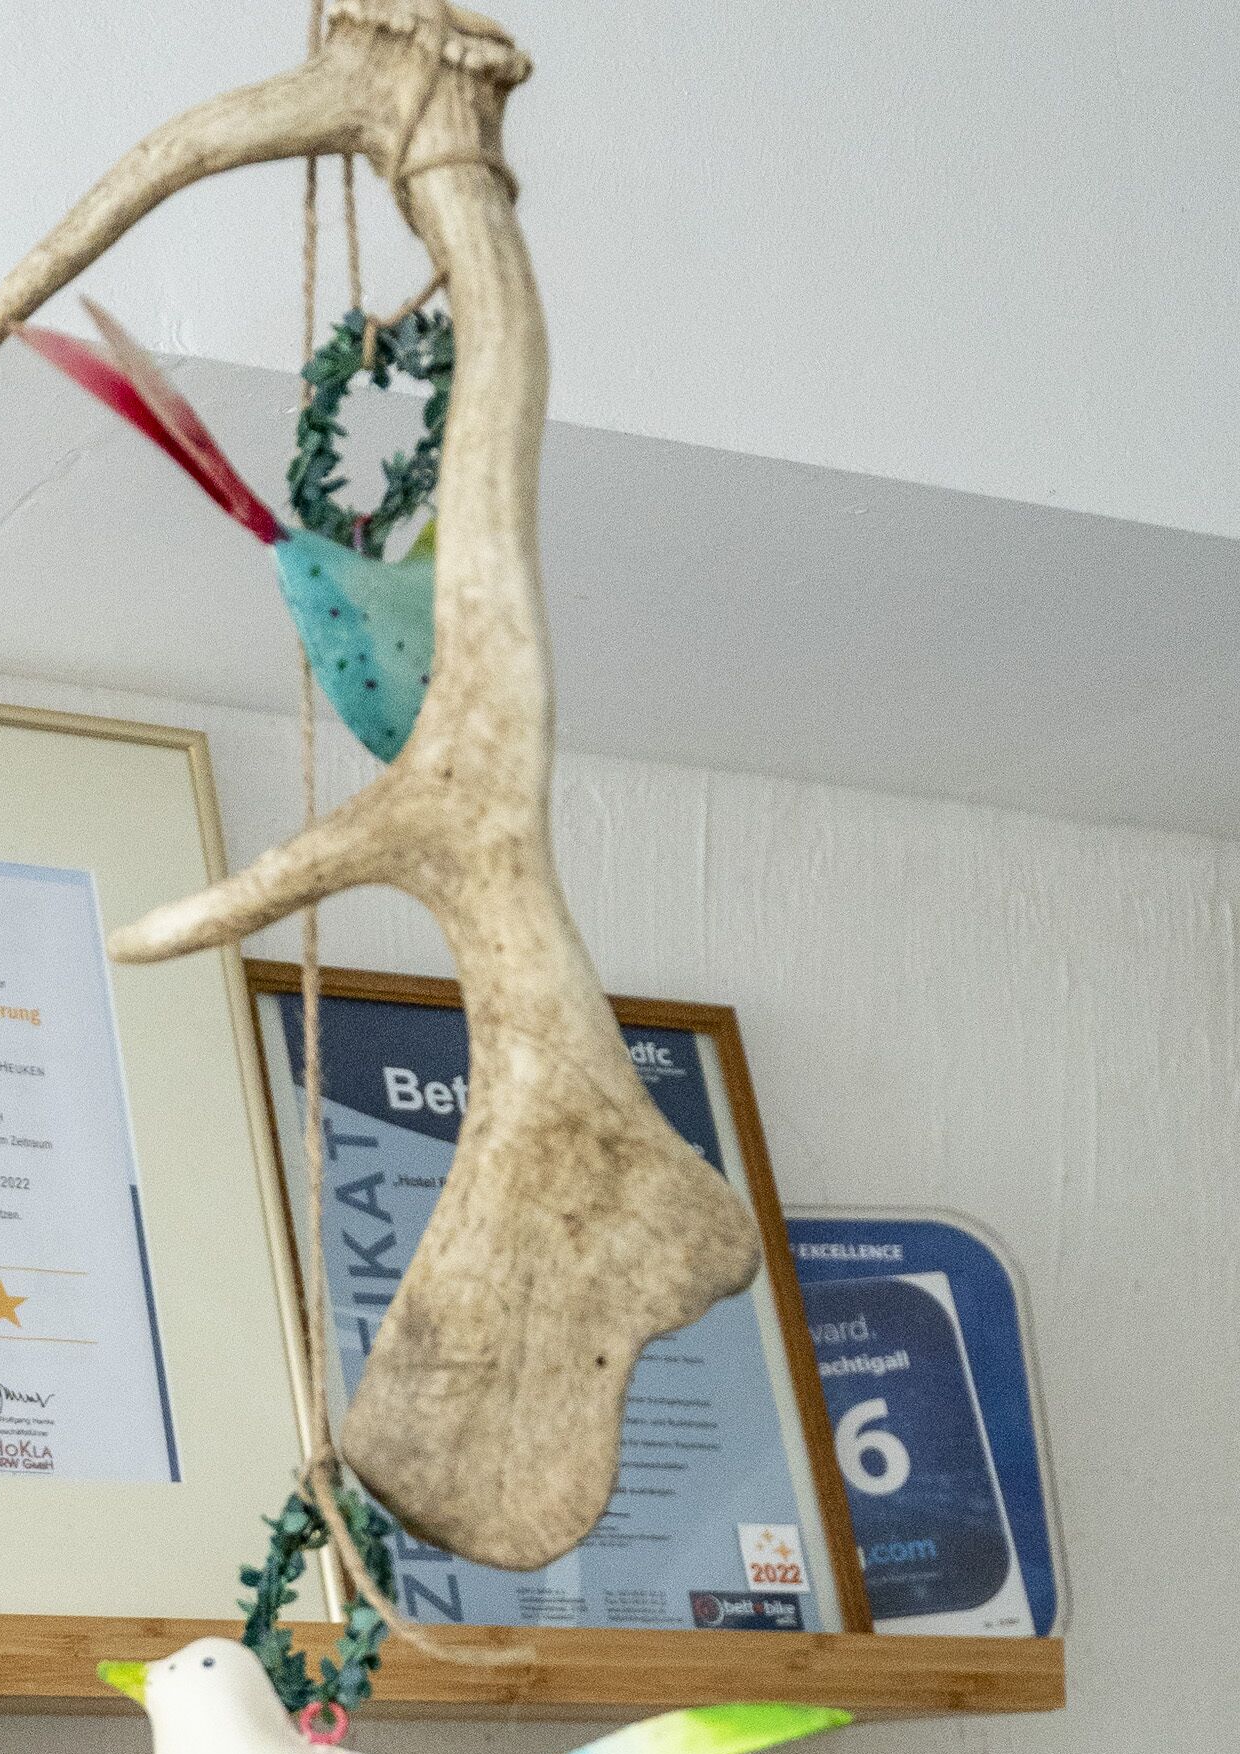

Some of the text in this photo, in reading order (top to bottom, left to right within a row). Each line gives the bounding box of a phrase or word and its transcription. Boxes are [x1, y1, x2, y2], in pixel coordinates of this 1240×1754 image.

[0, 1175, 30, 1191] 2022
[819, 1349, 910, 1377] achtigall
[750, 1562, 802, 1585] 2022
